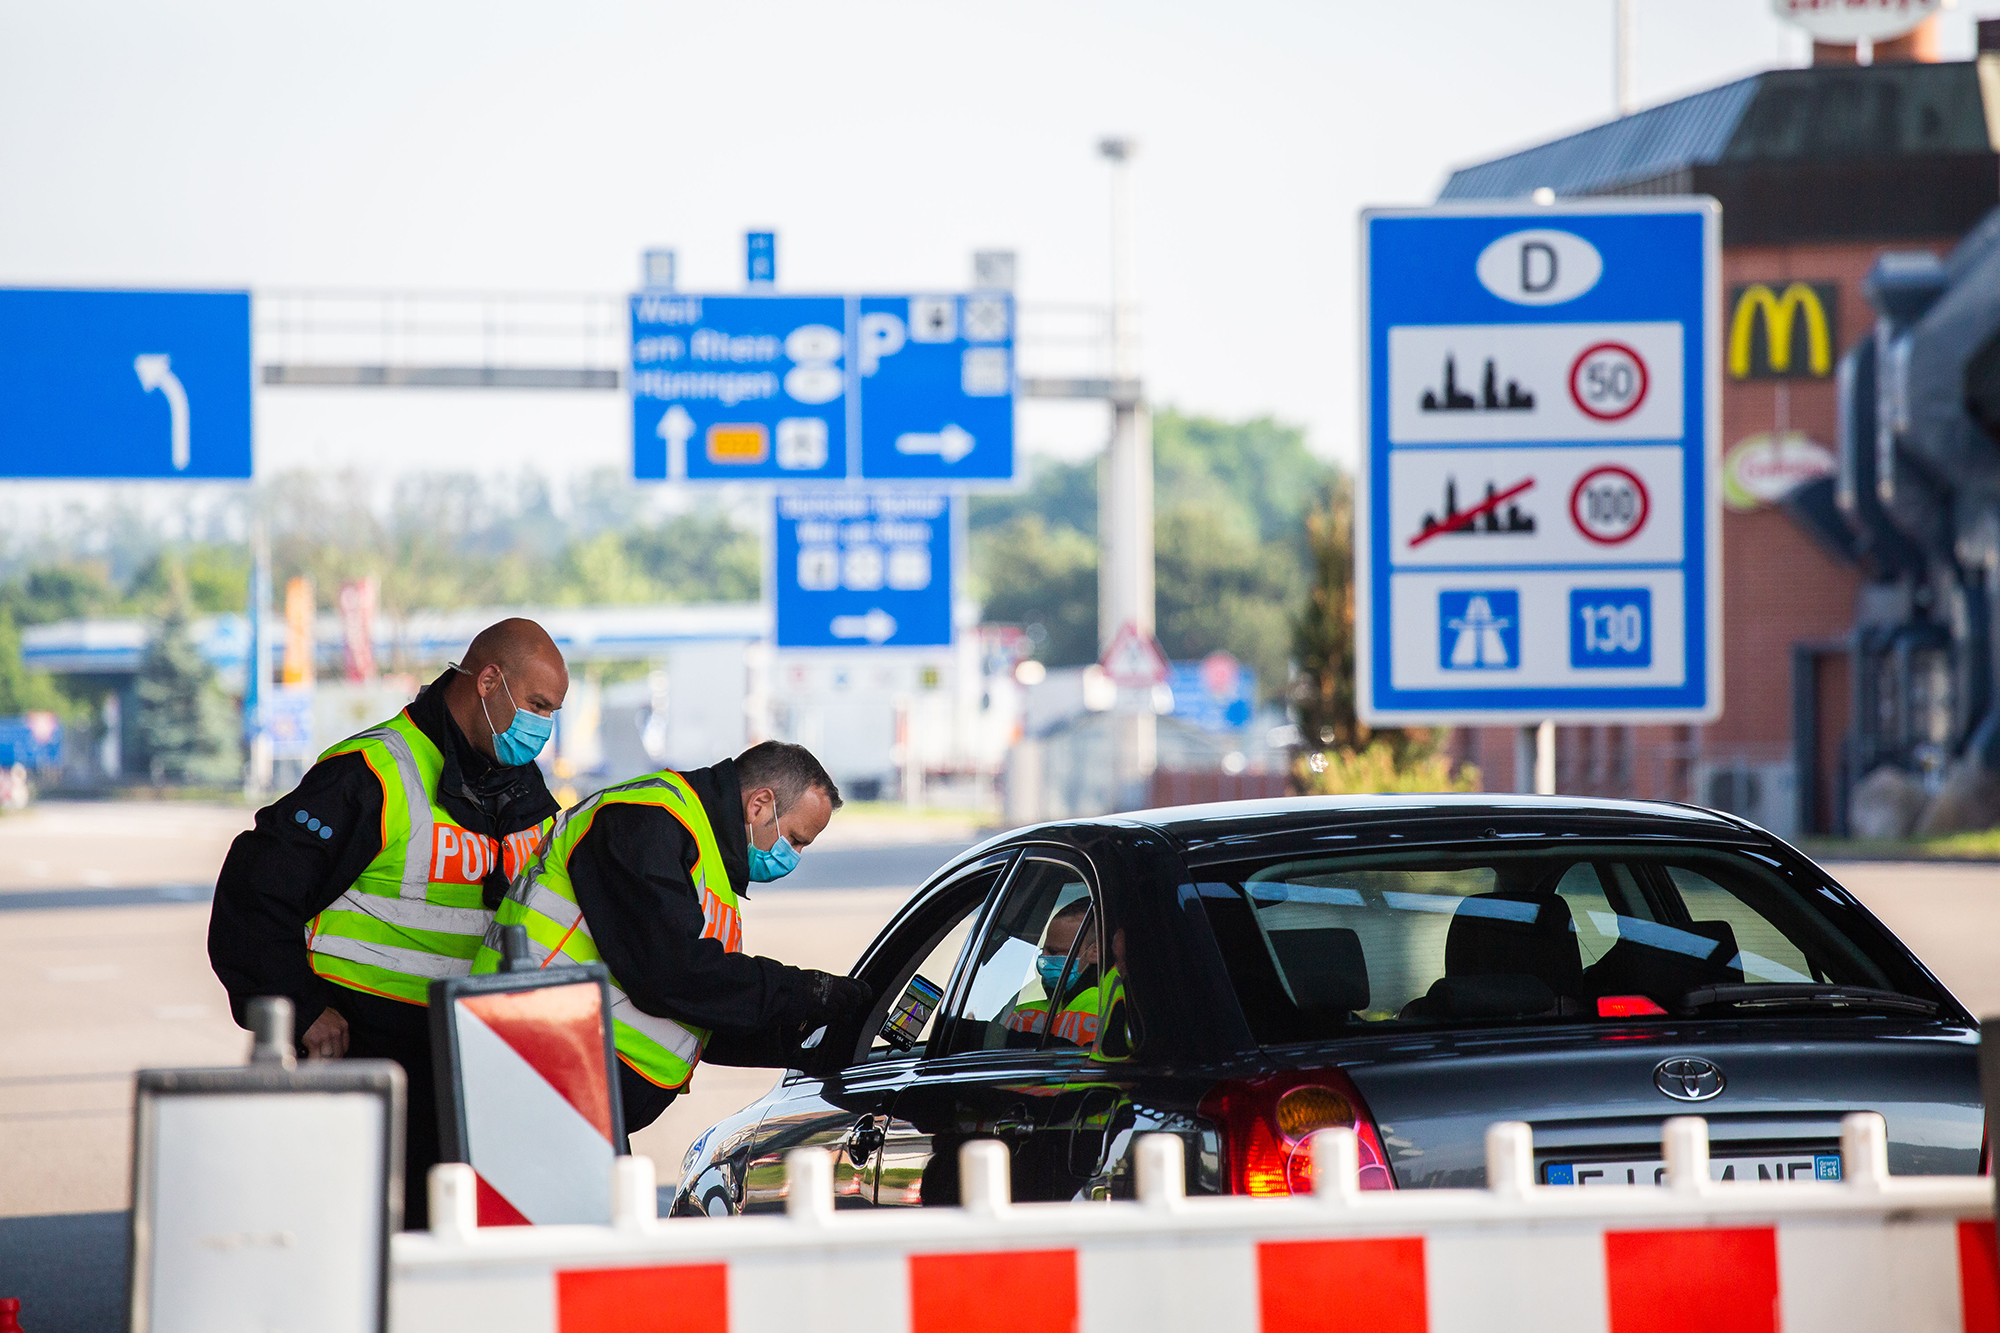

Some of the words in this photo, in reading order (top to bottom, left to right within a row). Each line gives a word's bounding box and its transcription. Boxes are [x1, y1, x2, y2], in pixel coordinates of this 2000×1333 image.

[1522, 242, 1558, 293] D
[859, 312, 905, 377] P
[1587, 362, 1634, 401] 50
[1586, 485, 1635, 525] 100
[1581, 603, 1642, 653] 130
